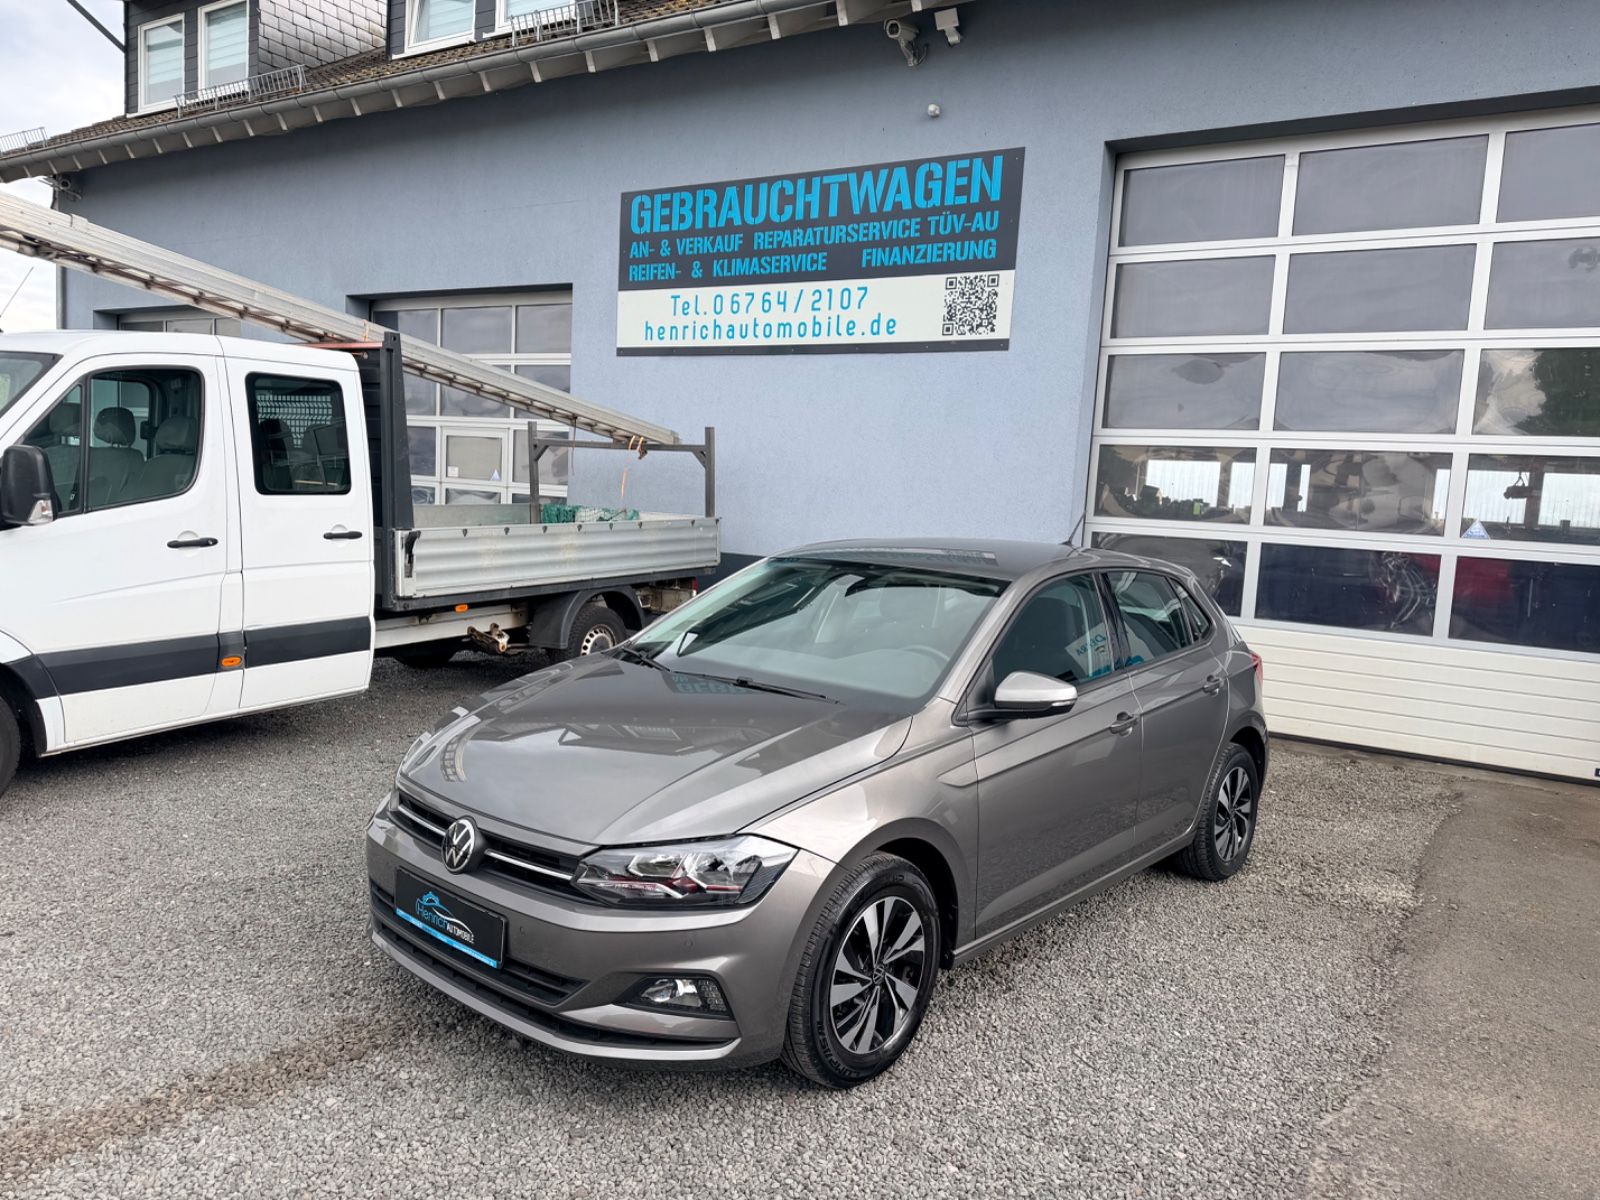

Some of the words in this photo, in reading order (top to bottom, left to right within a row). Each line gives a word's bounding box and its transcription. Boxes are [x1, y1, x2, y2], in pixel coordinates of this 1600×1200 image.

[630, 155, 1003, 235] GEBRAUCHTWAGEN
[629, 241, 655, 258] AN-
[660, 239, 671, 257] &
[676, 233, 744, 256] VERKAUF
[753, 218, 921, 251] REPARATURSERVICE
[927, 210, 999, 236] TÜV-AU
[629, 262, 682, 281] REIFEN-
[691, 260, 703, 278] &
[712, 252, 828, 277] KLIMASERVICE
[861, 238, 997, 268] FINANZIERUNG
[644, 313, 897, 341] henrichautomobile.de
